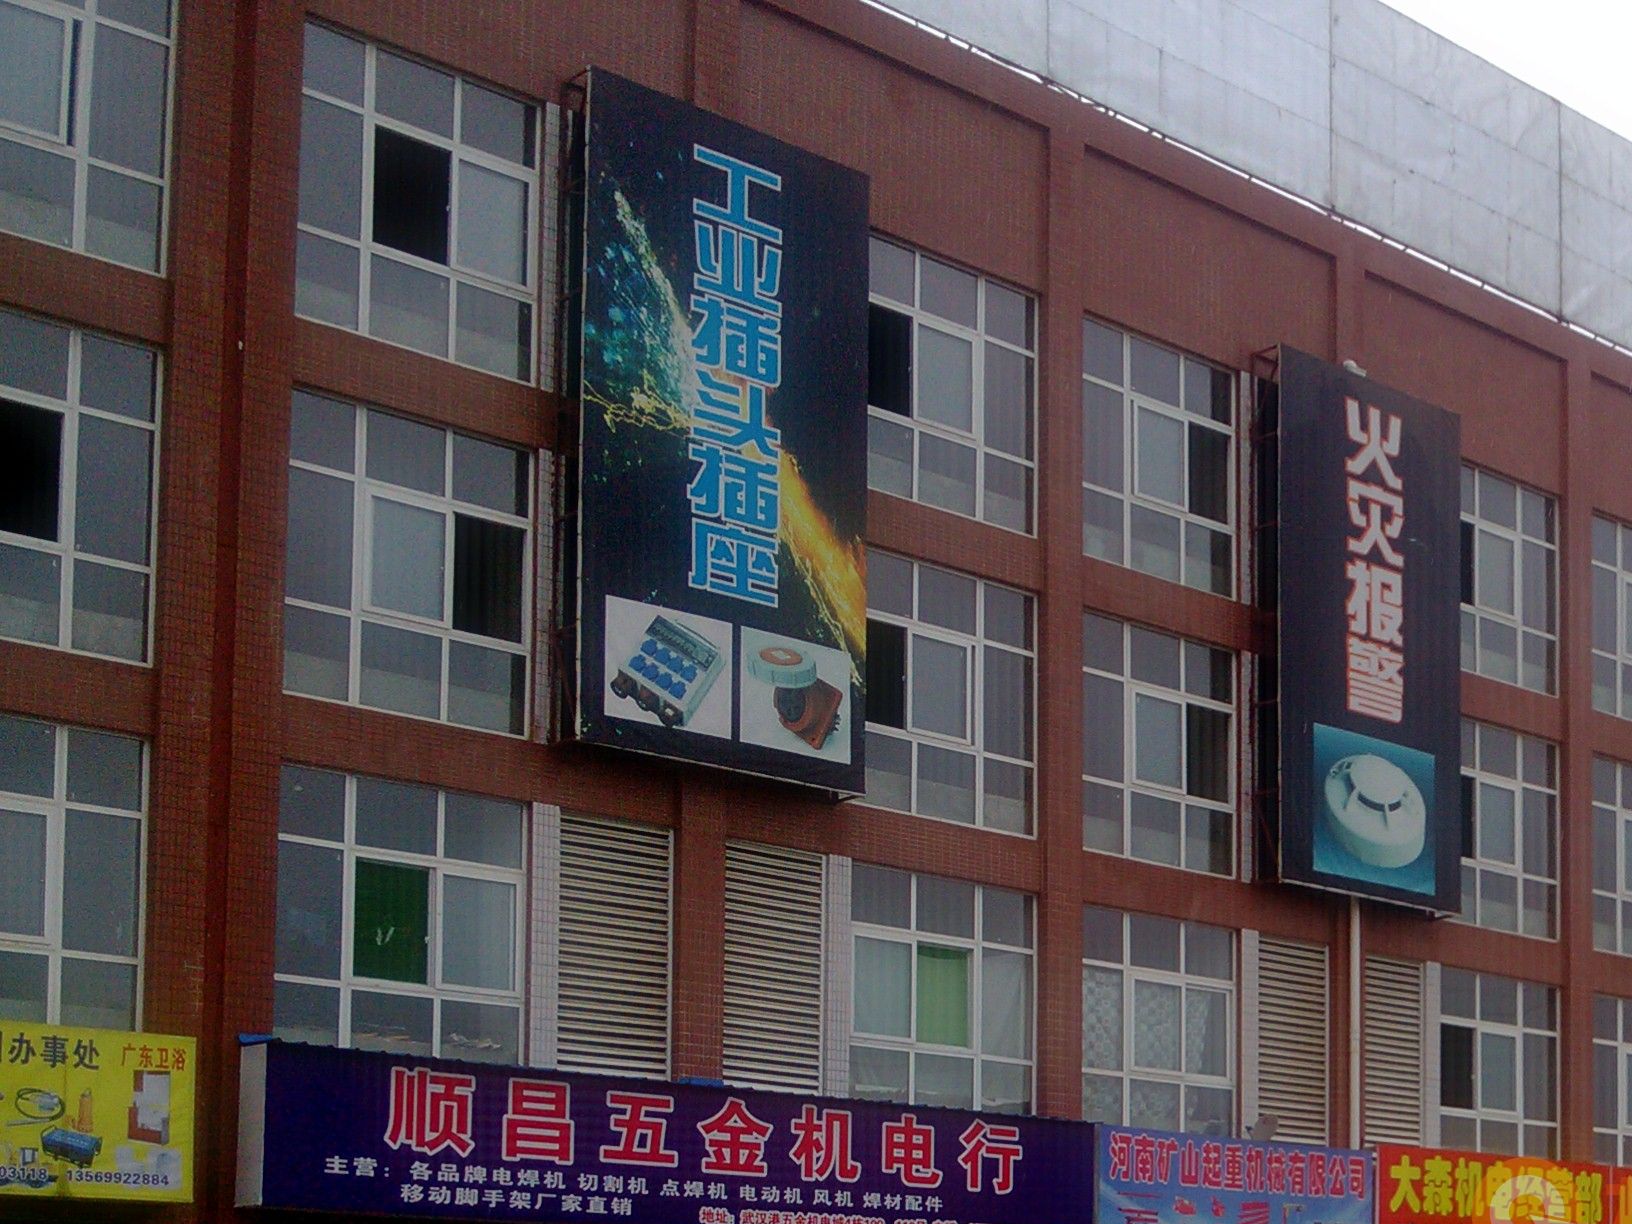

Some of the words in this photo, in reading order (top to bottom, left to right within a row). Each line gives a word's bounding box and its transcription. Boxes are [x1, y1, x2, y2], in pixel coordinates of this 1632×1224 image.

[687, 144, 782, 607] 工业插头插座
[1345, 395, 1404, 724] 火灾报警
[0, 1030, 100, 1071] 办事处
[121, 1043, 187, 1072] 广东卫浴
[384, 1066, 1023, 1195] 顺昌五金机电行
[66, 1169, 170, 1186] 13569922884
[409, 1160, 567, 1191] 各品牌电焊机
[577, 1173, 650, 1195] 切割机
[659, 1178, 728, 1201] 点焊机
[739, 1184, 803, 1206] 电动机
[812, 1188, 854, 1209] 风机
[862, 1191, 944, 1214] 焊材配件
[1108, 1129, 1367, 1202] 河南矿山起重机械有限公司
[400, 1183, 633, 1217] 移动脚手架厂家直销
